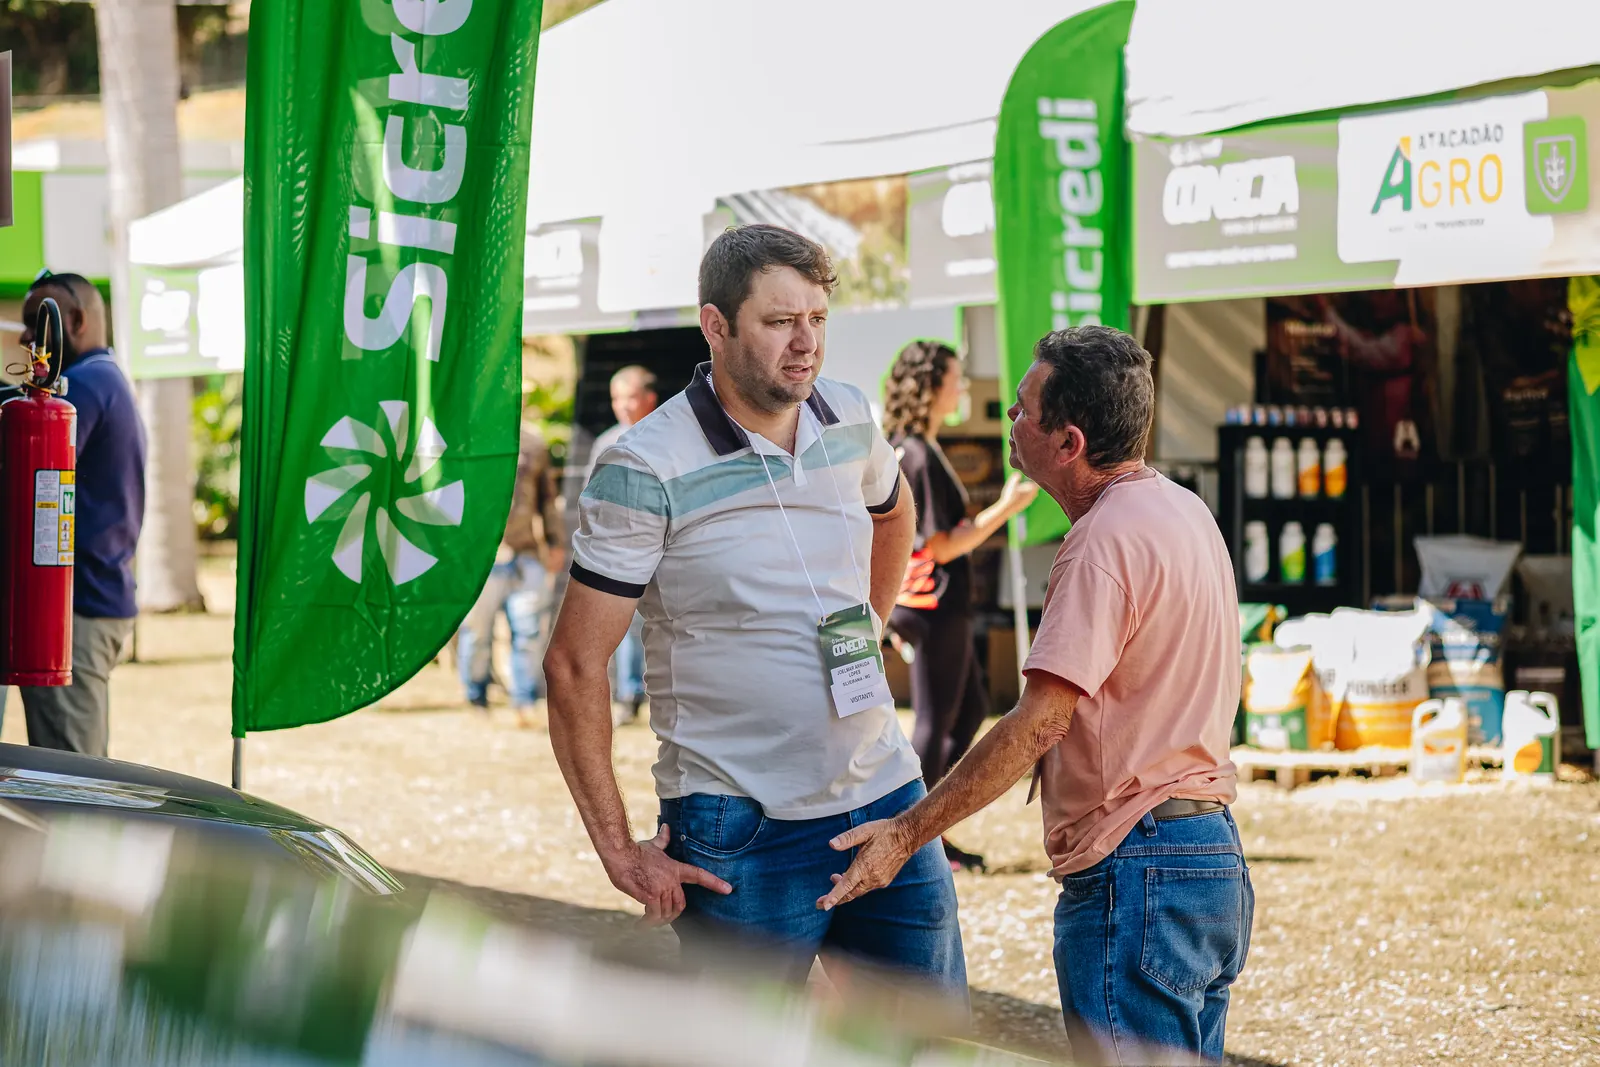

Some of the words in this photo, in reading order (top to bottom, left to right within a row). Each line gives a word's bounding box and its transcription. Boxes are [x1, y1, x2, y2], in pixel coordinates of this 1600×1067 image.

[1370, 135, 1503, 215] AGRO
[833, 636, 868, 656] CONECTA
[838, 666, 855, 675] JOELMAR
[850, 691, 874, 703] VISITANTE
